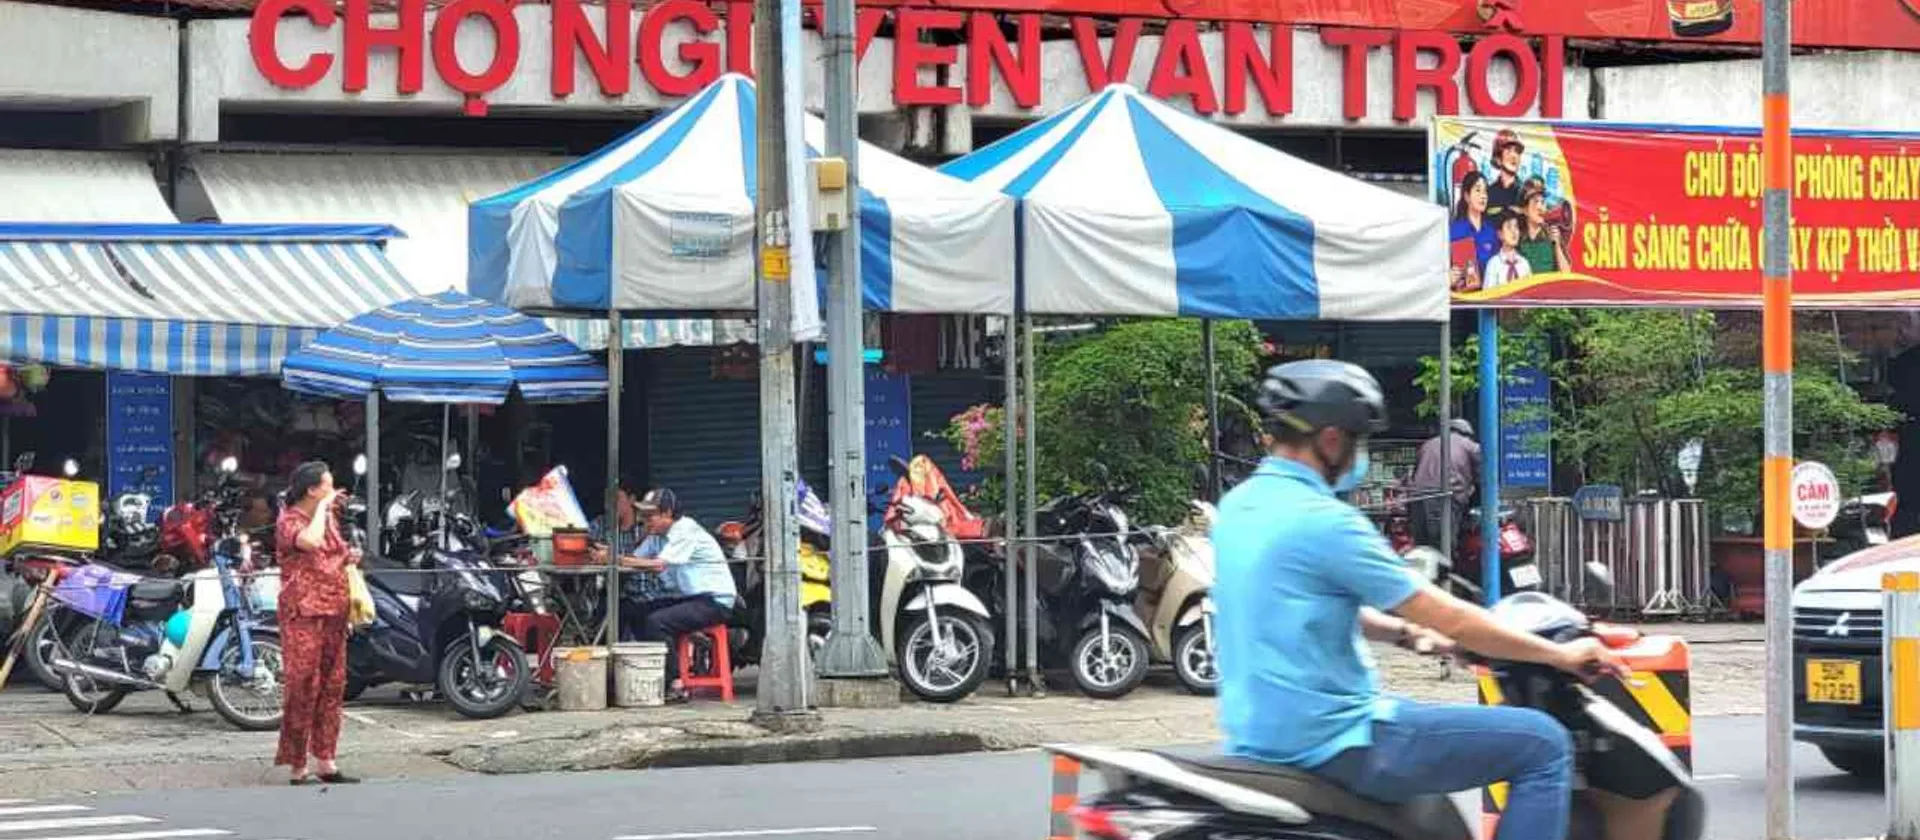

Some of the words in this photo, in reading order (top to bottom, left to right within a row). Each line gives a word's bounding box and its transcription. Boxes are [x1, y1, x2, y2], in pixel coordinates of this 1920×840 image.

[250, 0, 520, 116] CHỢ
[1684, 137, 1727, 198] CHỦ
[1732, 143, 1764, 208] ĐỘ
[1794, 143, 1864, 201] PHÒNG
[1869, 145, 1920, 201] CHÁY
[1583, 206, 1627, 269] SẴN
[1632, 213, 1690, 270] SÀNG
[1696, 216, 1752, 270] CHỮA
[1817, 226, 1850, 283] KỊP
[1856, 216, 1901, 272] THỜI
